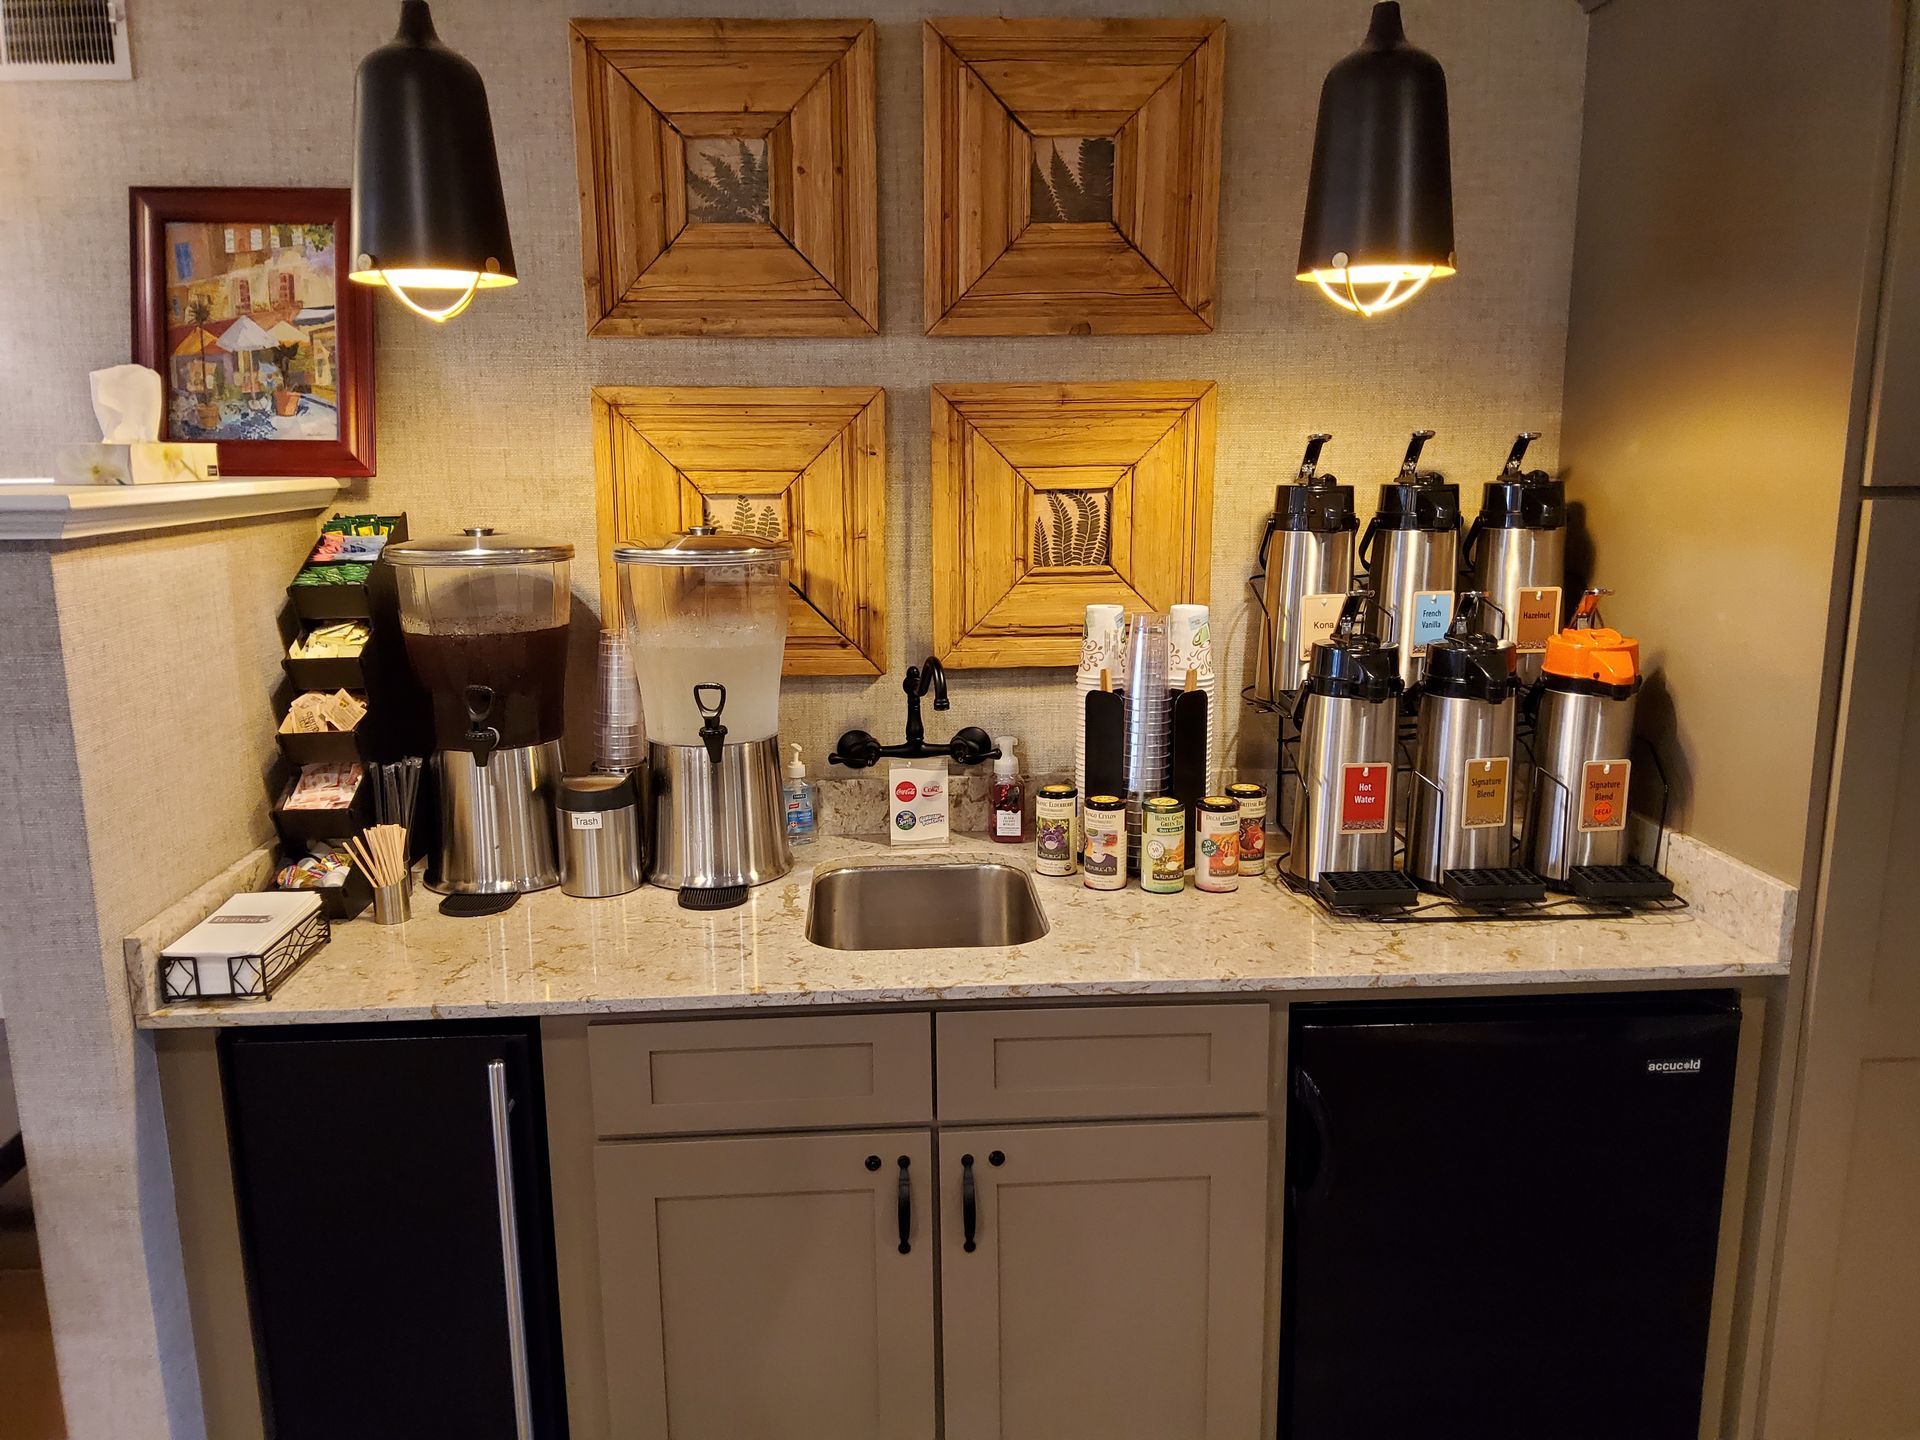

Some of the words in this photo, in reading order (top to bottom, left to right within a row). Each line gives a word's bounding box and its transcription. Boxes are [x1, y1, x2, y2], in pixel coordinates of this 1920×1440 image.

[1523, 611, 1550, 619] Hazelnut
[1313, 621, 1334, 629] Kona
[1359, 783, 1371, 791] Hot
[1471, 778, 1501, 787] Signature
[1590, 781, 1620, 790] Signature
[896, 787, 916, 796] Coca-Cola
[1477, 789, 1495, 798] Blend
[1595, 792, 1613, 801] Blend
[575, 817, 598, 825] Trash
[1648, 1060, 1701, 1071] accucold
